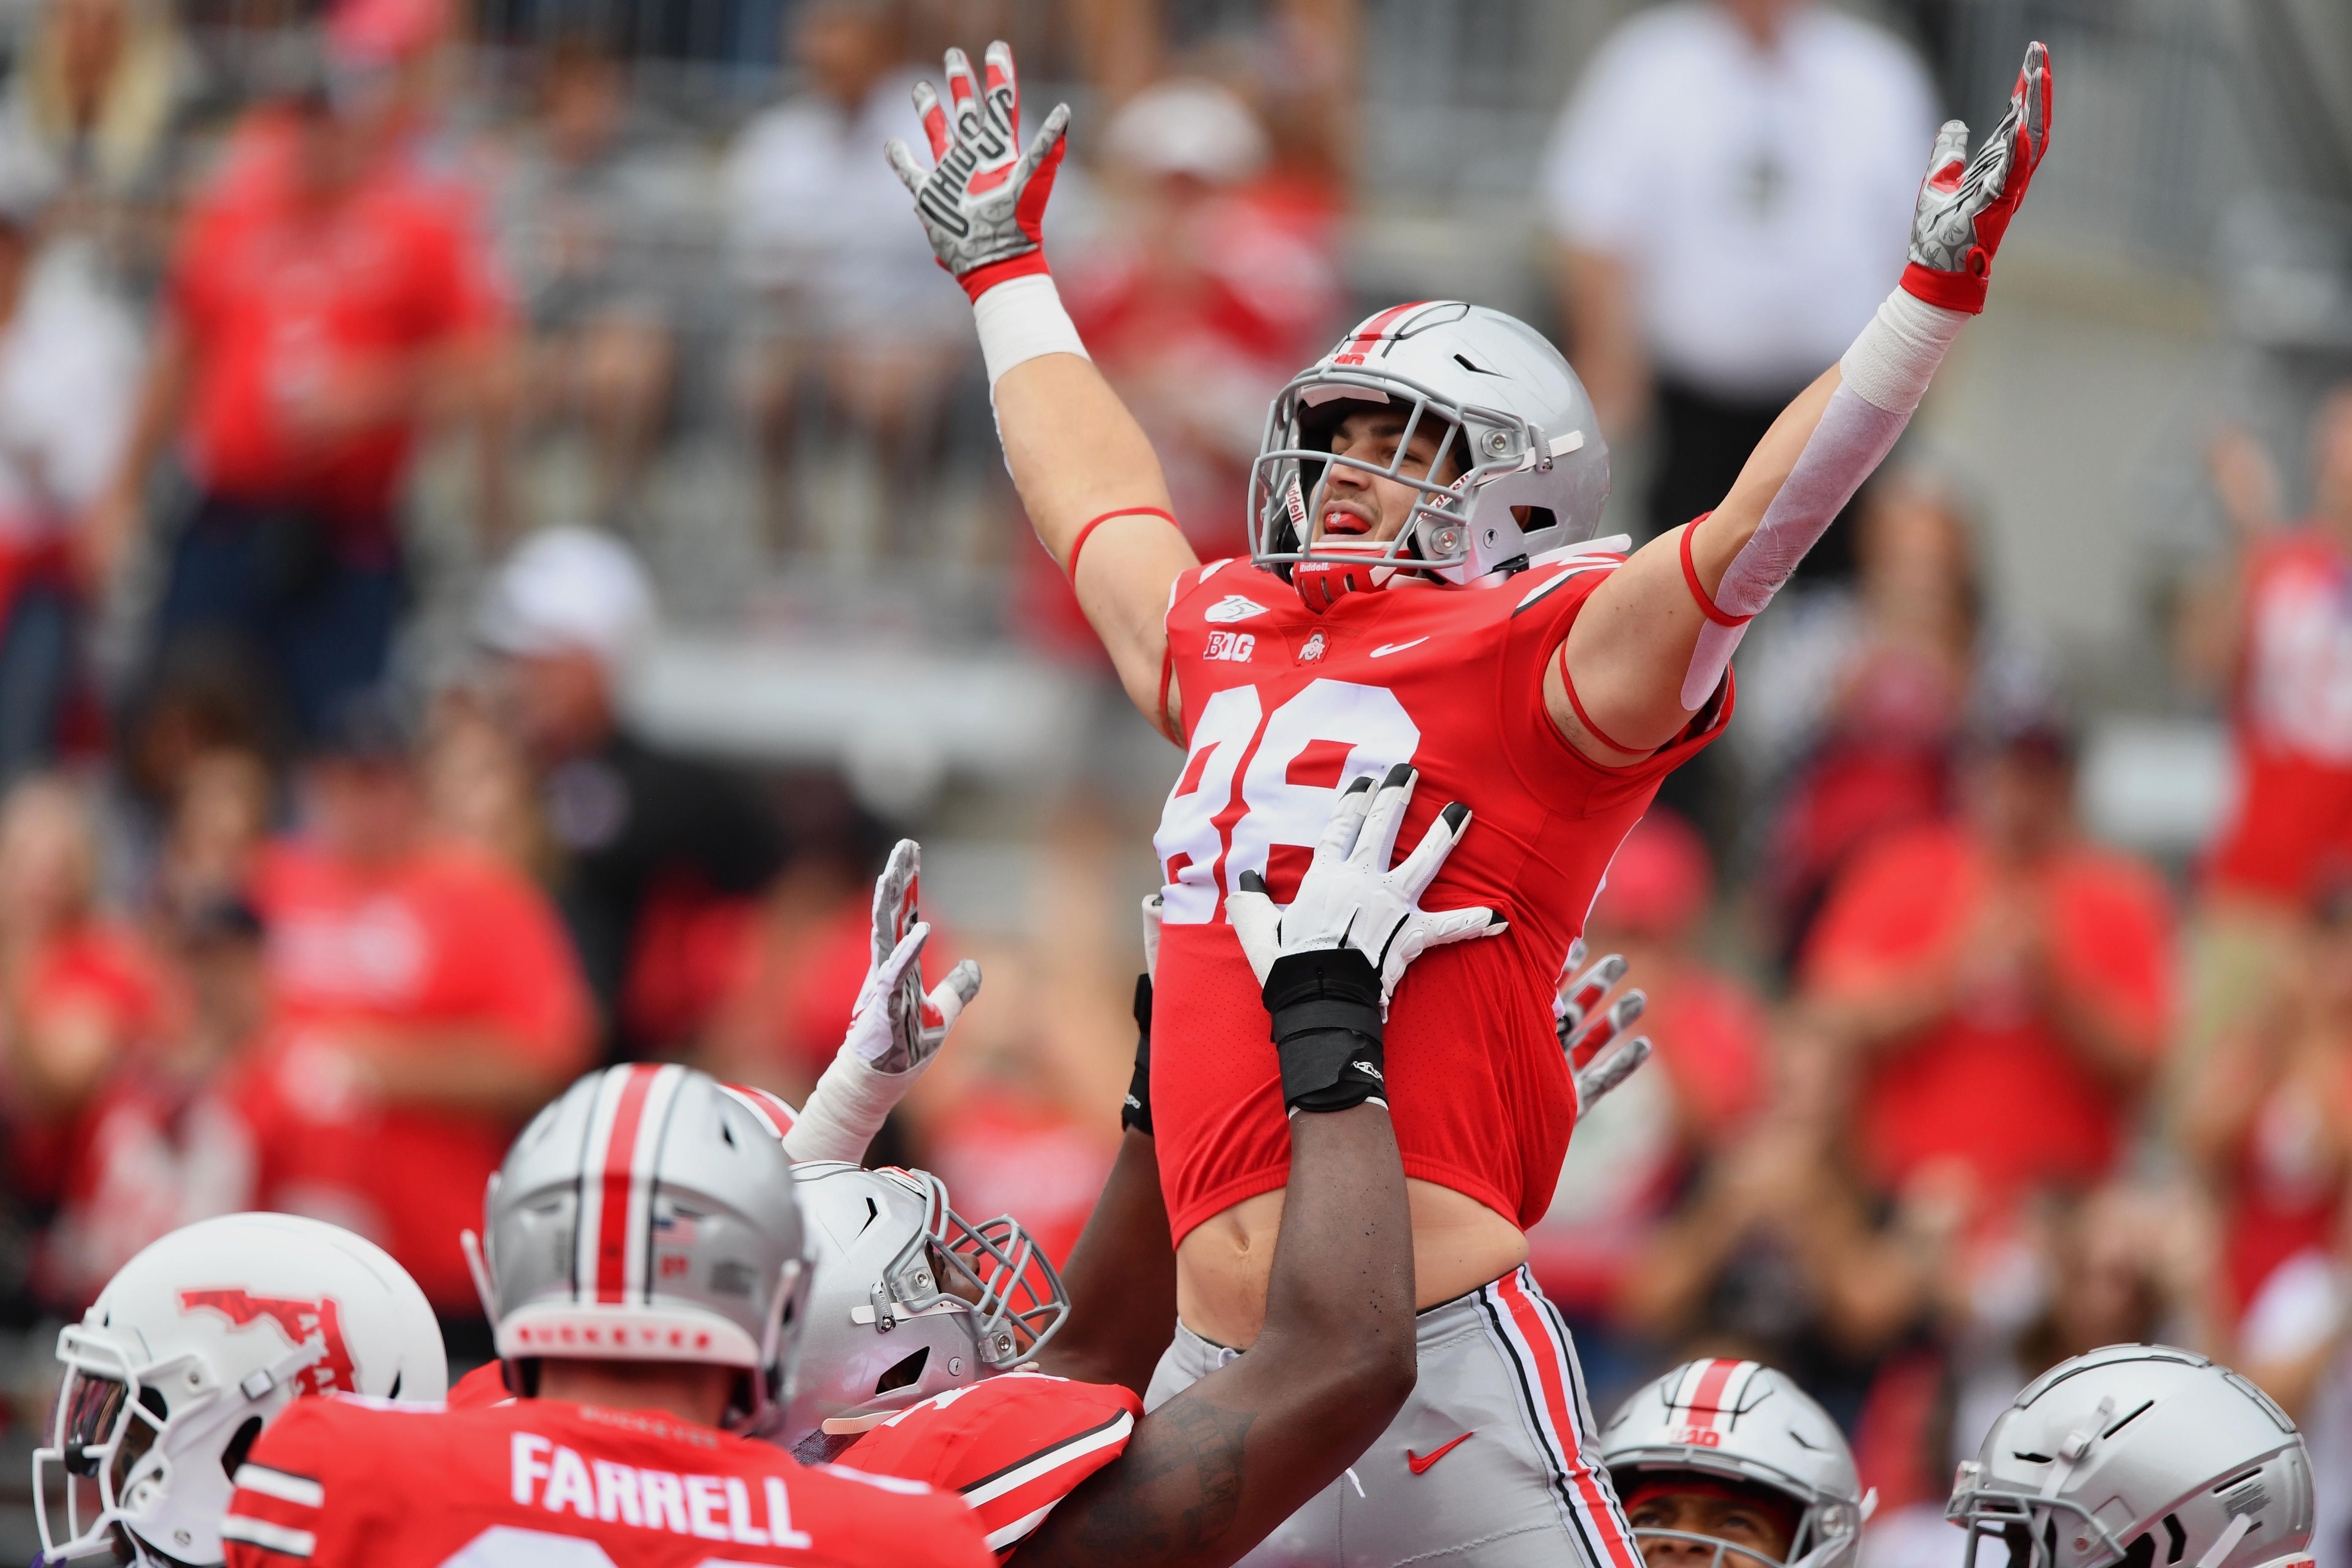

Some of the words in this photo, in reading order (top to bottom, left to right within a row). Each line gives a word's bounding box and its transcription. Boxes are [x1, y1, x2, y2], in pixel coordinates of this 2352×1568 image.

[1299, 562, 1328, 573] Riddell
[1152, 678, 1421, 925] 88
[798, 1428, 822, 1446] WARNING
[510, 1431, 812, 1550] FARRELL
